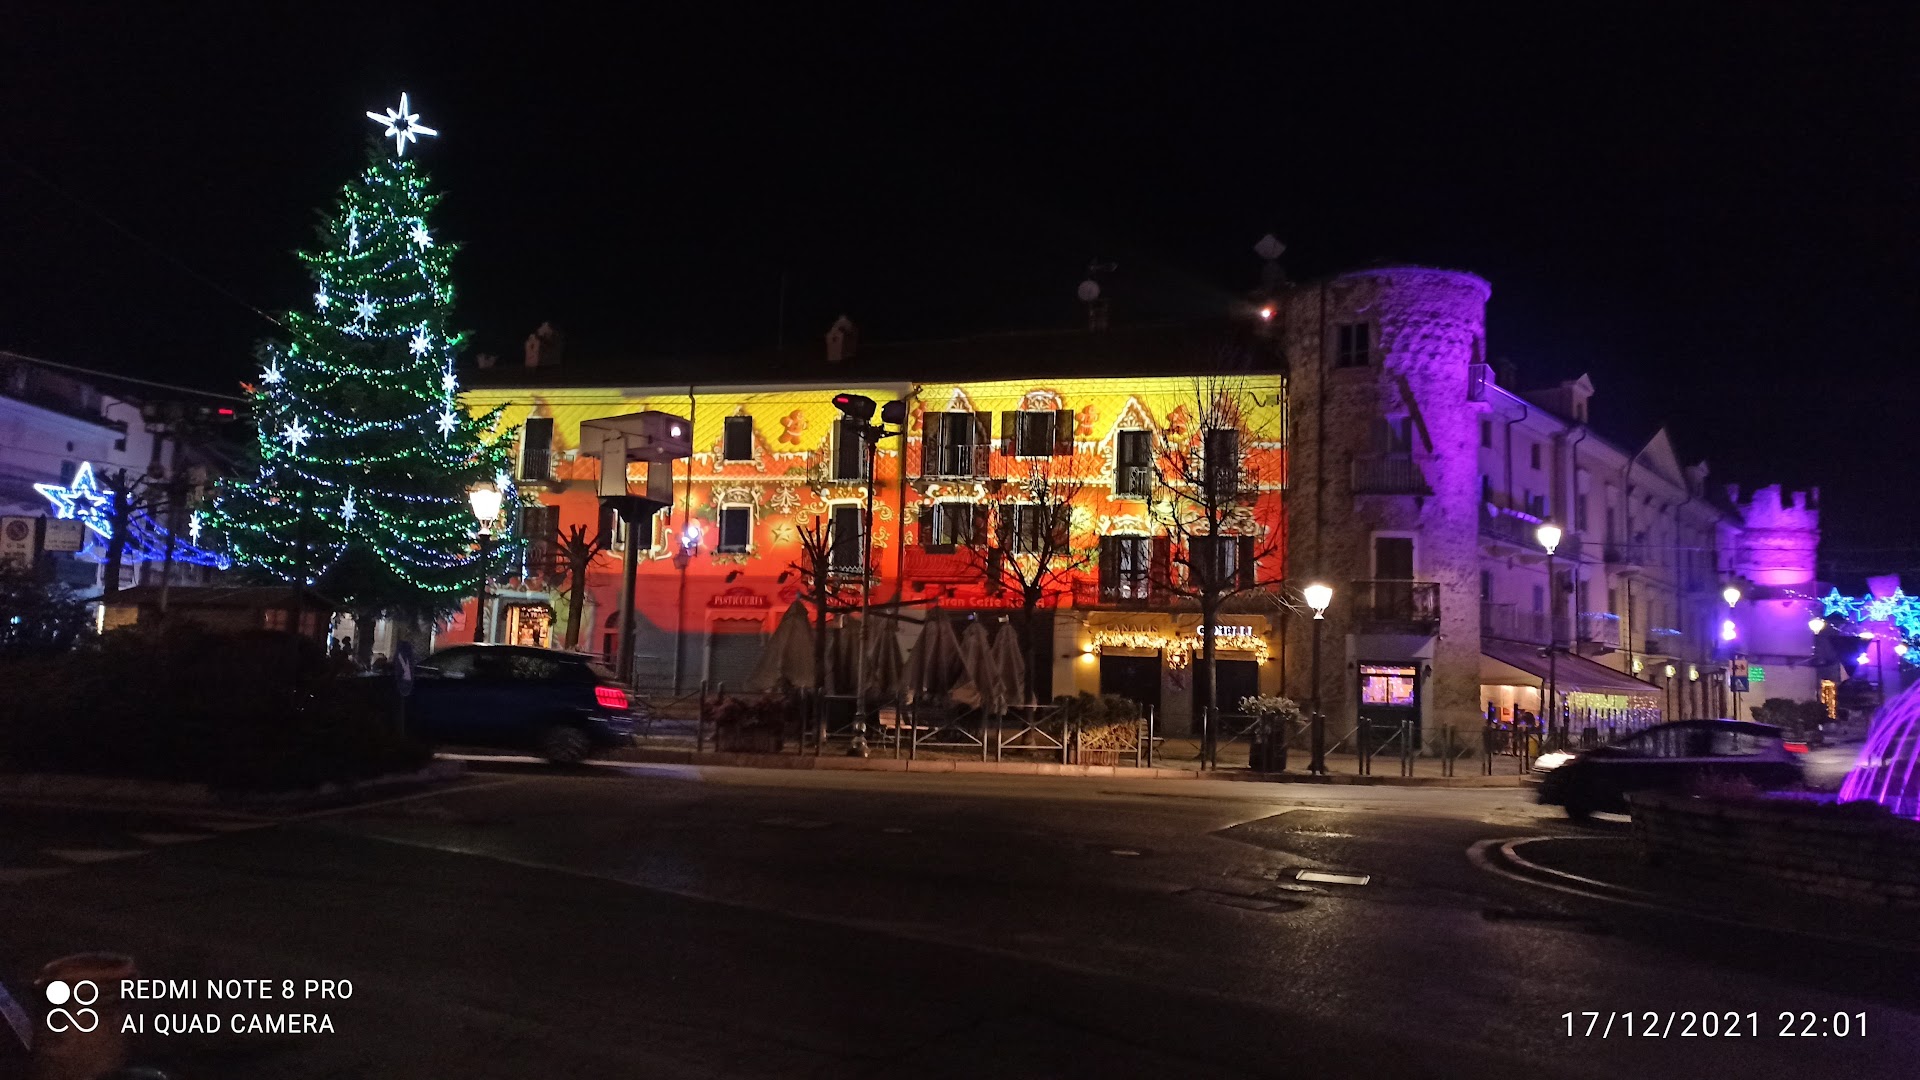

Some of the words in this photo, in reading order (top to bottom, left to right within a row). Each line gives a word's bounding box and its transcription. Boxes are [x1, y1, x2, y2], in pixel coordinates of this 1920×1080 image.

[714, 595, 764, 605] PASTICCERIA
[1006, 598, 1045, 609] ROA
[1105, 623, 1158, 633] CANALIS
